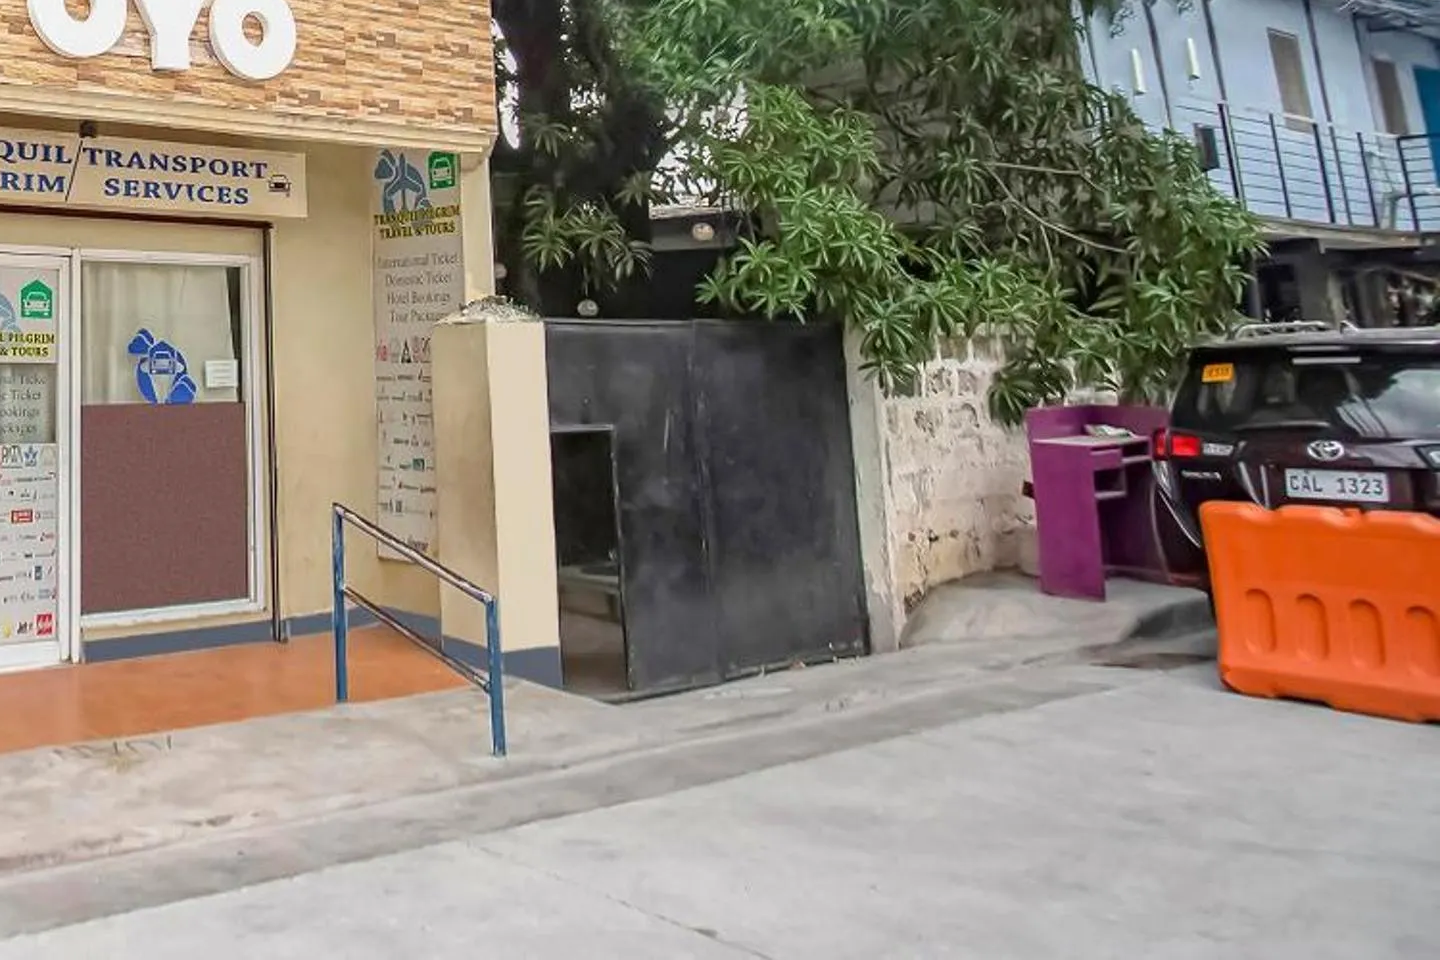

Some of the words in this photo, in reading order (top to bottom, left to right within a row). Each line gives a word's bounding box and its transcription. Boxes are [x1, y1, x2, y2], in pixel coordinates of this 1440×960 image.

[83, 147, 268, 179] TRANSPORT
[104, 178, 249, 205] SERVICES
[8, 332, 55, 345] PILGRIM
[11, 346, 49, 357] TOURS
[1289, 475, 1323, 493] CAL
[1336, 477, 1384, 495] 1323
